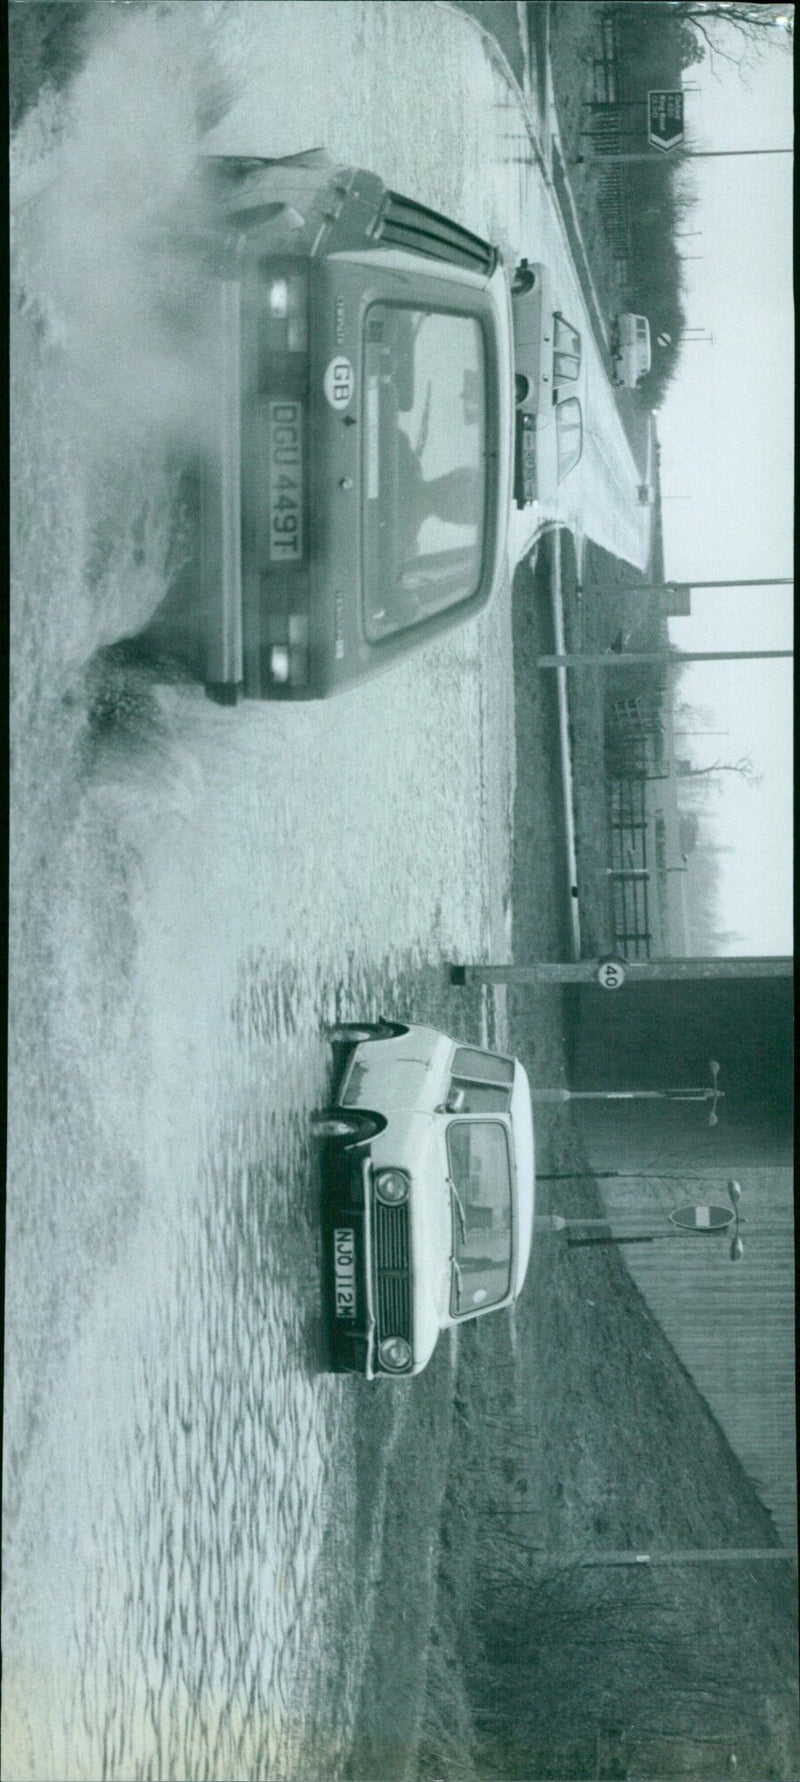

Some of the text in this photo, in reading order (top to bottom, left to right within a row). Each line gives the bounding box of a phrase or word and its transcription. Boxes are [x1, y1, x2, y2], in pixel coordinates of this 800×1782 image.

[334, 365, 350, 400] GB
[272, 405, 298, 553] DGU 449T
[605, 966, 618, 986] 40
[336, 1231, 353, 1316] NJO 112M
